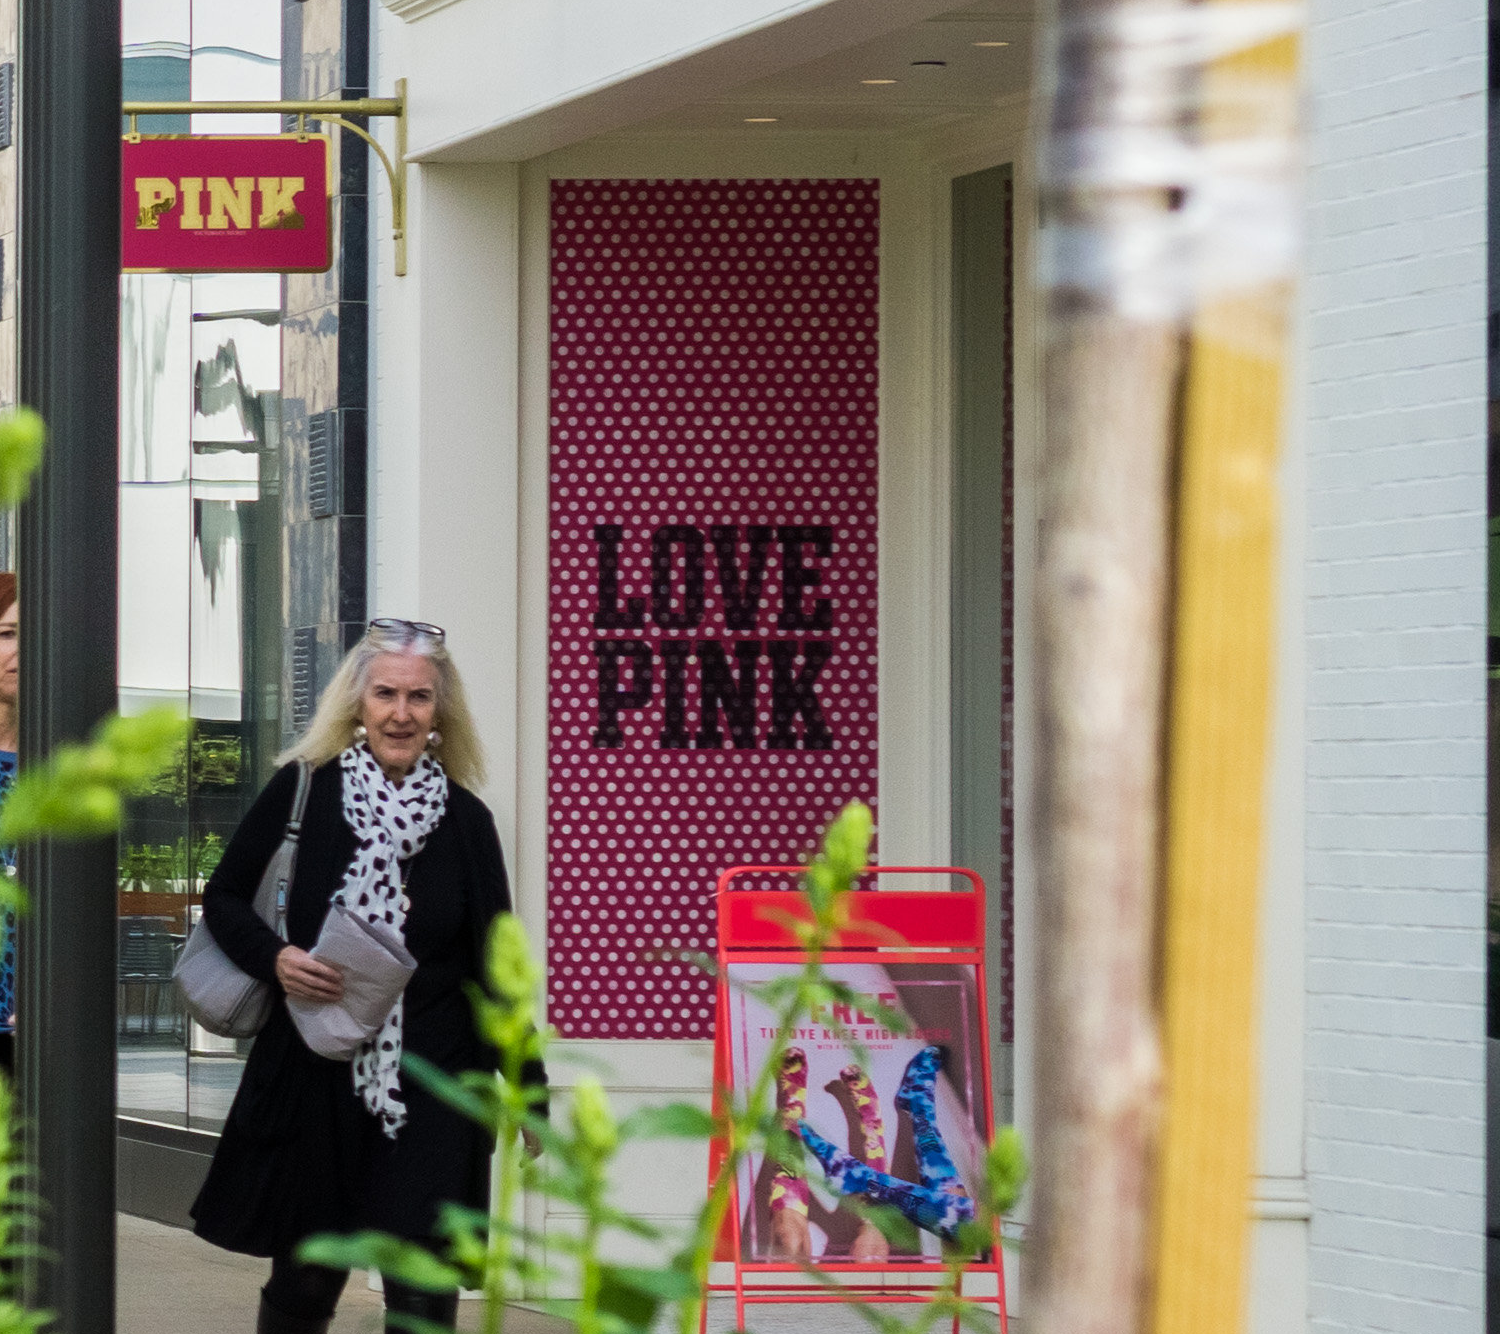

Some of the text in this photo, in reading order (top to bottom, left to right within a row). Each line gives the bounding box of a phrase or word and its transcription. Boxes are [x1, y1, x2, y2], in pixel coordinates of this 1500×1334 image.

[135, 177, 305, 230] PINK
[593, 524, 834, 631] LOVE
[593, 640, 834, 750] PINK
